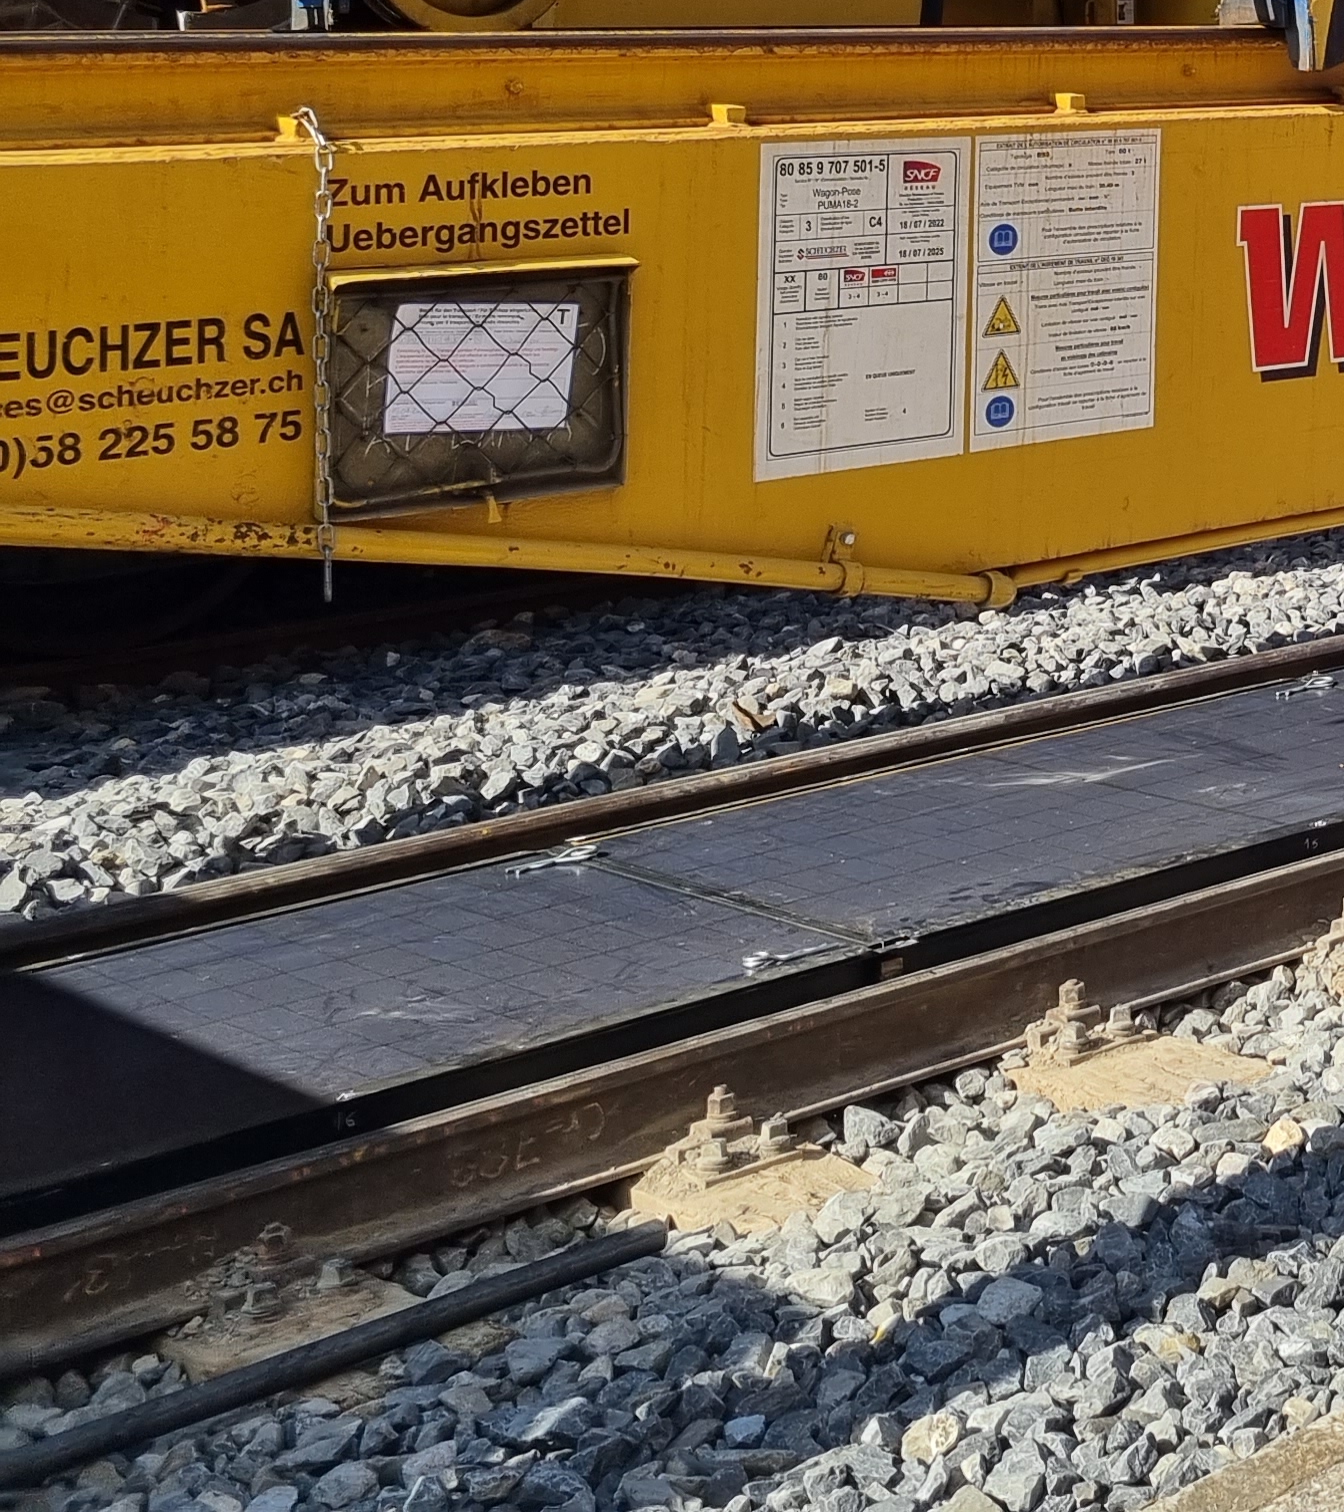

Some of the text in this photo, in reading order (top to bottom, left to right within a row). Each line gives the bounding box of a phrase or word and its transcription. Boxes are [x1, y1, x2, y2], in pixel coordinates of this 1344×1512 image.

[779, 159, 885, 176] 80 85 9 707 501-5
[905, 168, 939, 181] SNCF
[330, 170, 592, 208] Zum Aufkleben
[805, 220, 812, 232] 3
[869, 216, 882, 227] C4
[326, 208, 631, 255] Uebergangszettel
[845, 273, 864, 282] SNCF
[557, 309, 570, 324] T
[243, 311, 305, 361] SA
[0, 370, 303, 420] es@scheuchzer.ch
[98, 422, 175, 461] 225
[191, 416, 239, 451] 58
[254, 409, 302, 444] 75
